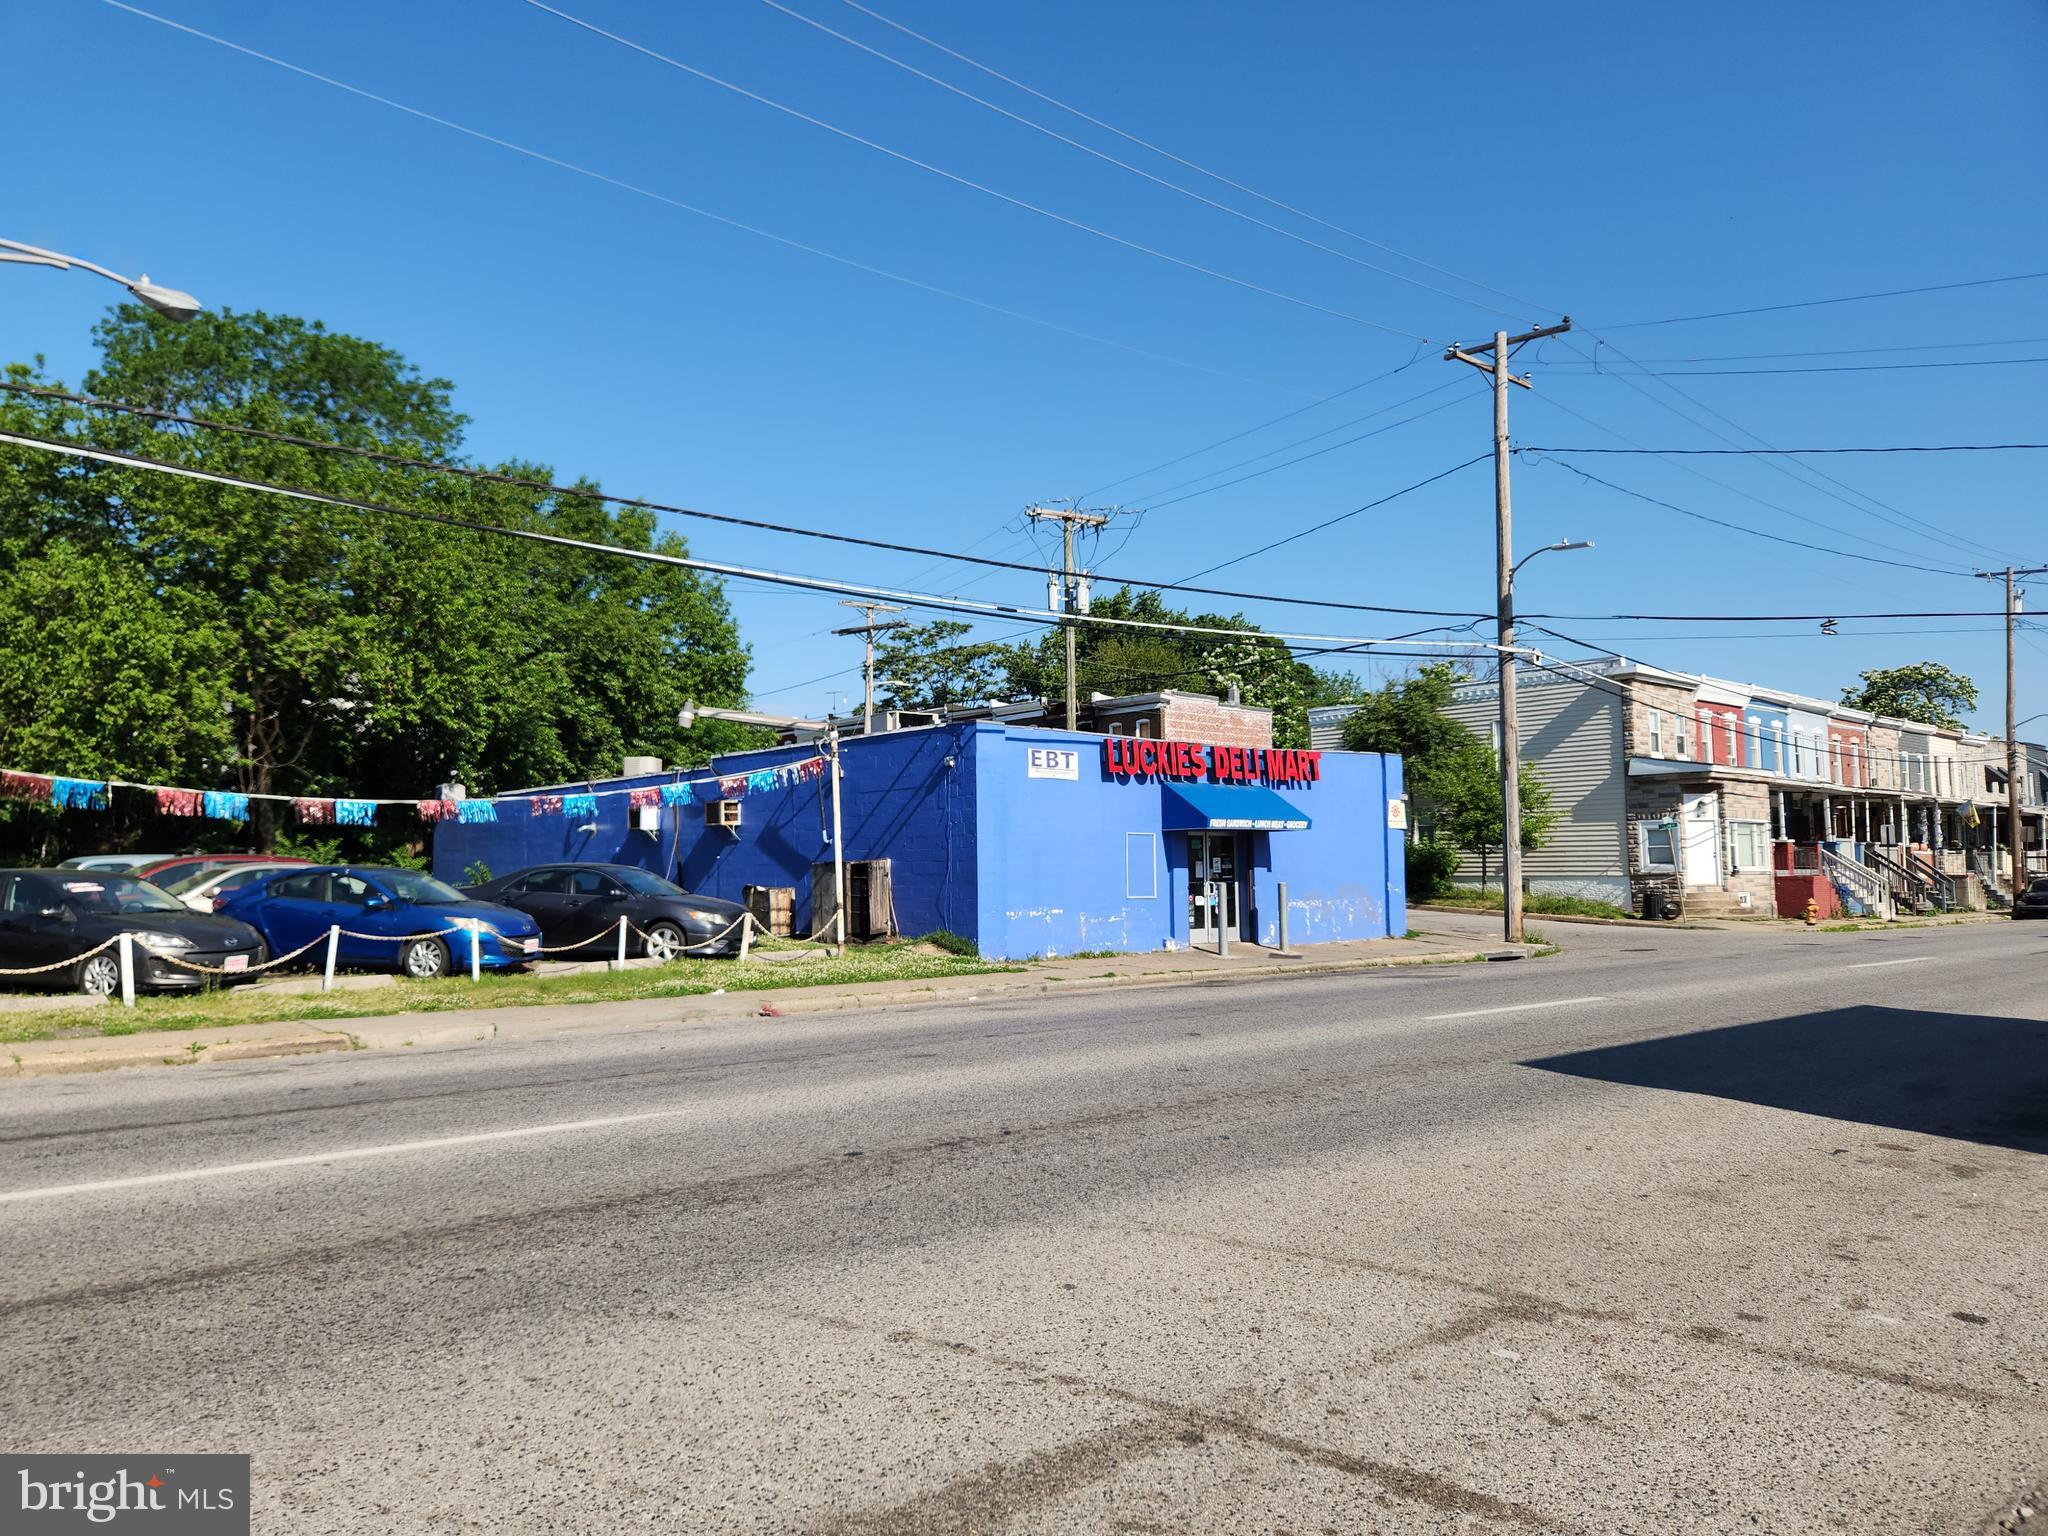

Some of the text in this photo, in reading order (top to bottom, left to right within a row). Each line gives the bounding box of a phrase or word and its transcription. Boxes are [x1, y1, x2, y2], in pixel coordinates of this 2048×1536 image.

[1031, 750, 1075, 769] EBT
[1106, 739, 1321, 781] LUCKIES DELI MART
